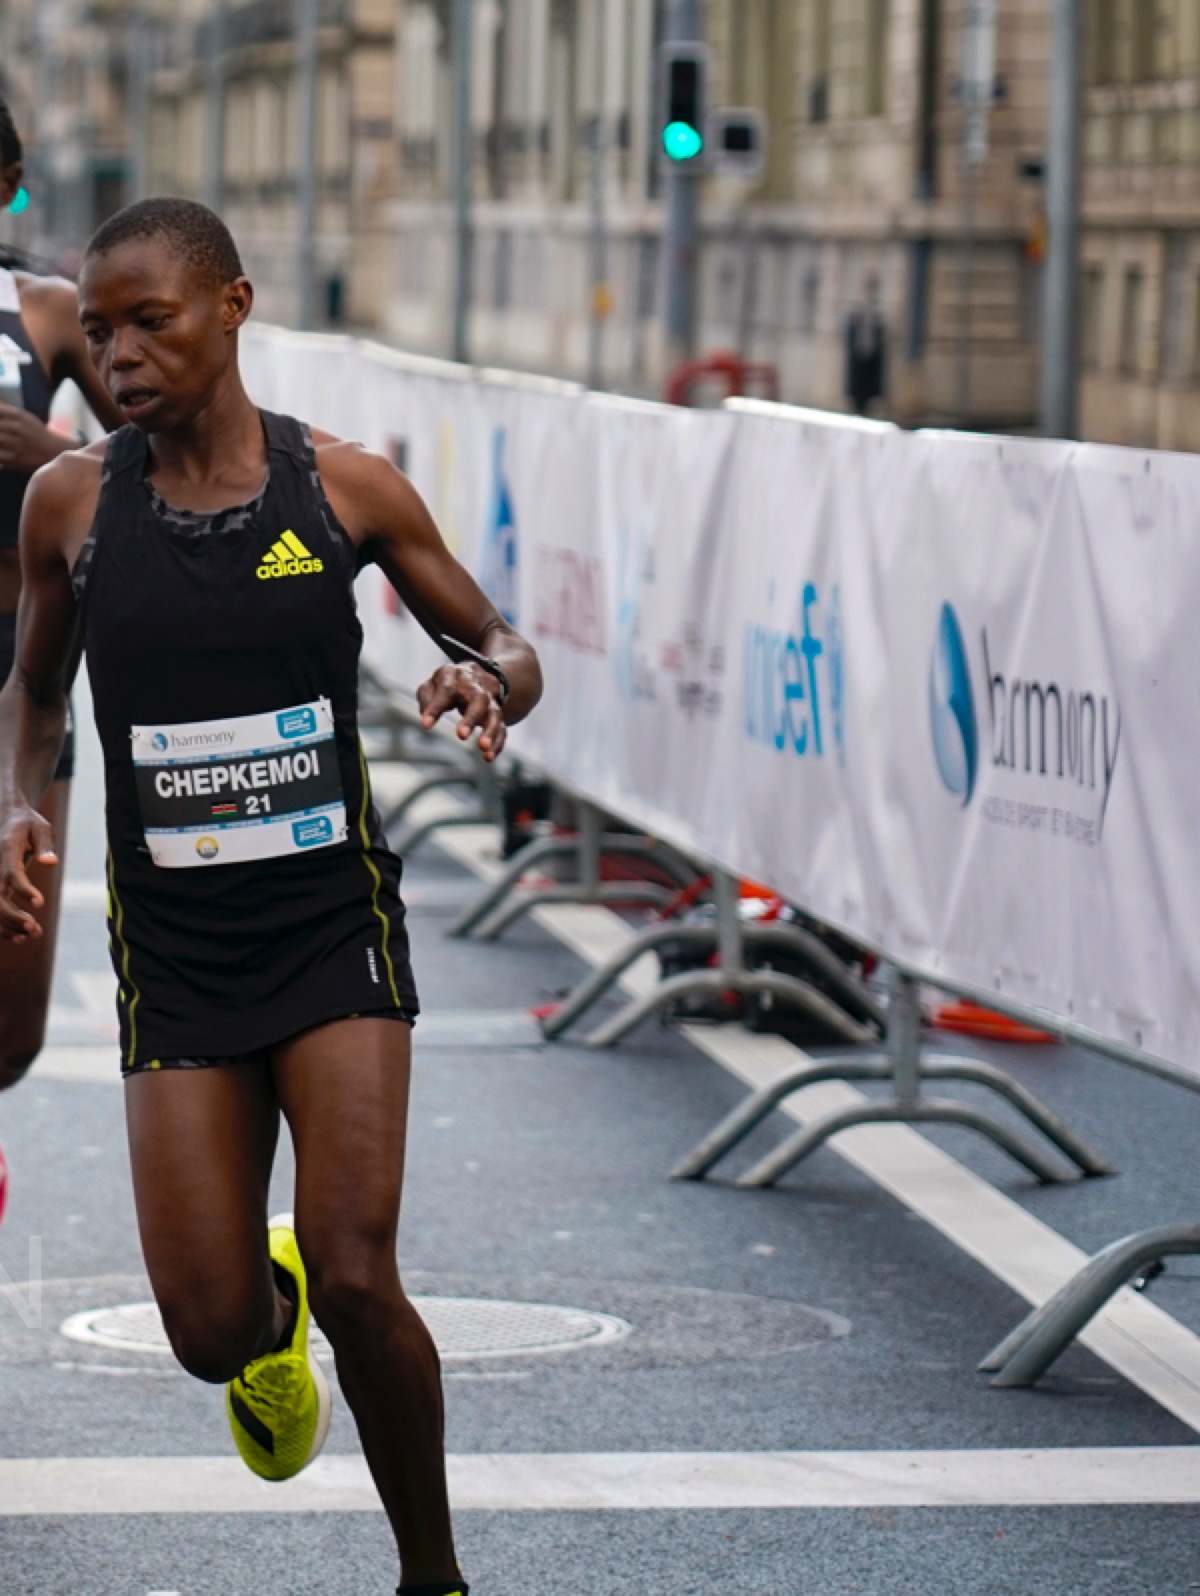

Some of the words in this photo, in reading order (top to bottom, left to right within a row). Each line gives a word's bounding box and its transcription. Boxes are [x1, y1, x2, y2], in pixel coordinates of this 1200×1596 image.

[255, 557, 324, 579] adidas
[745, 579, 823, 756] unicef
[170, 730, 236, 748] harmony
[980, 624, 1121, 843] harmony
[154, 749, 321, 799] CHEPKEMOI
[244, 793, 272, 815] 21
